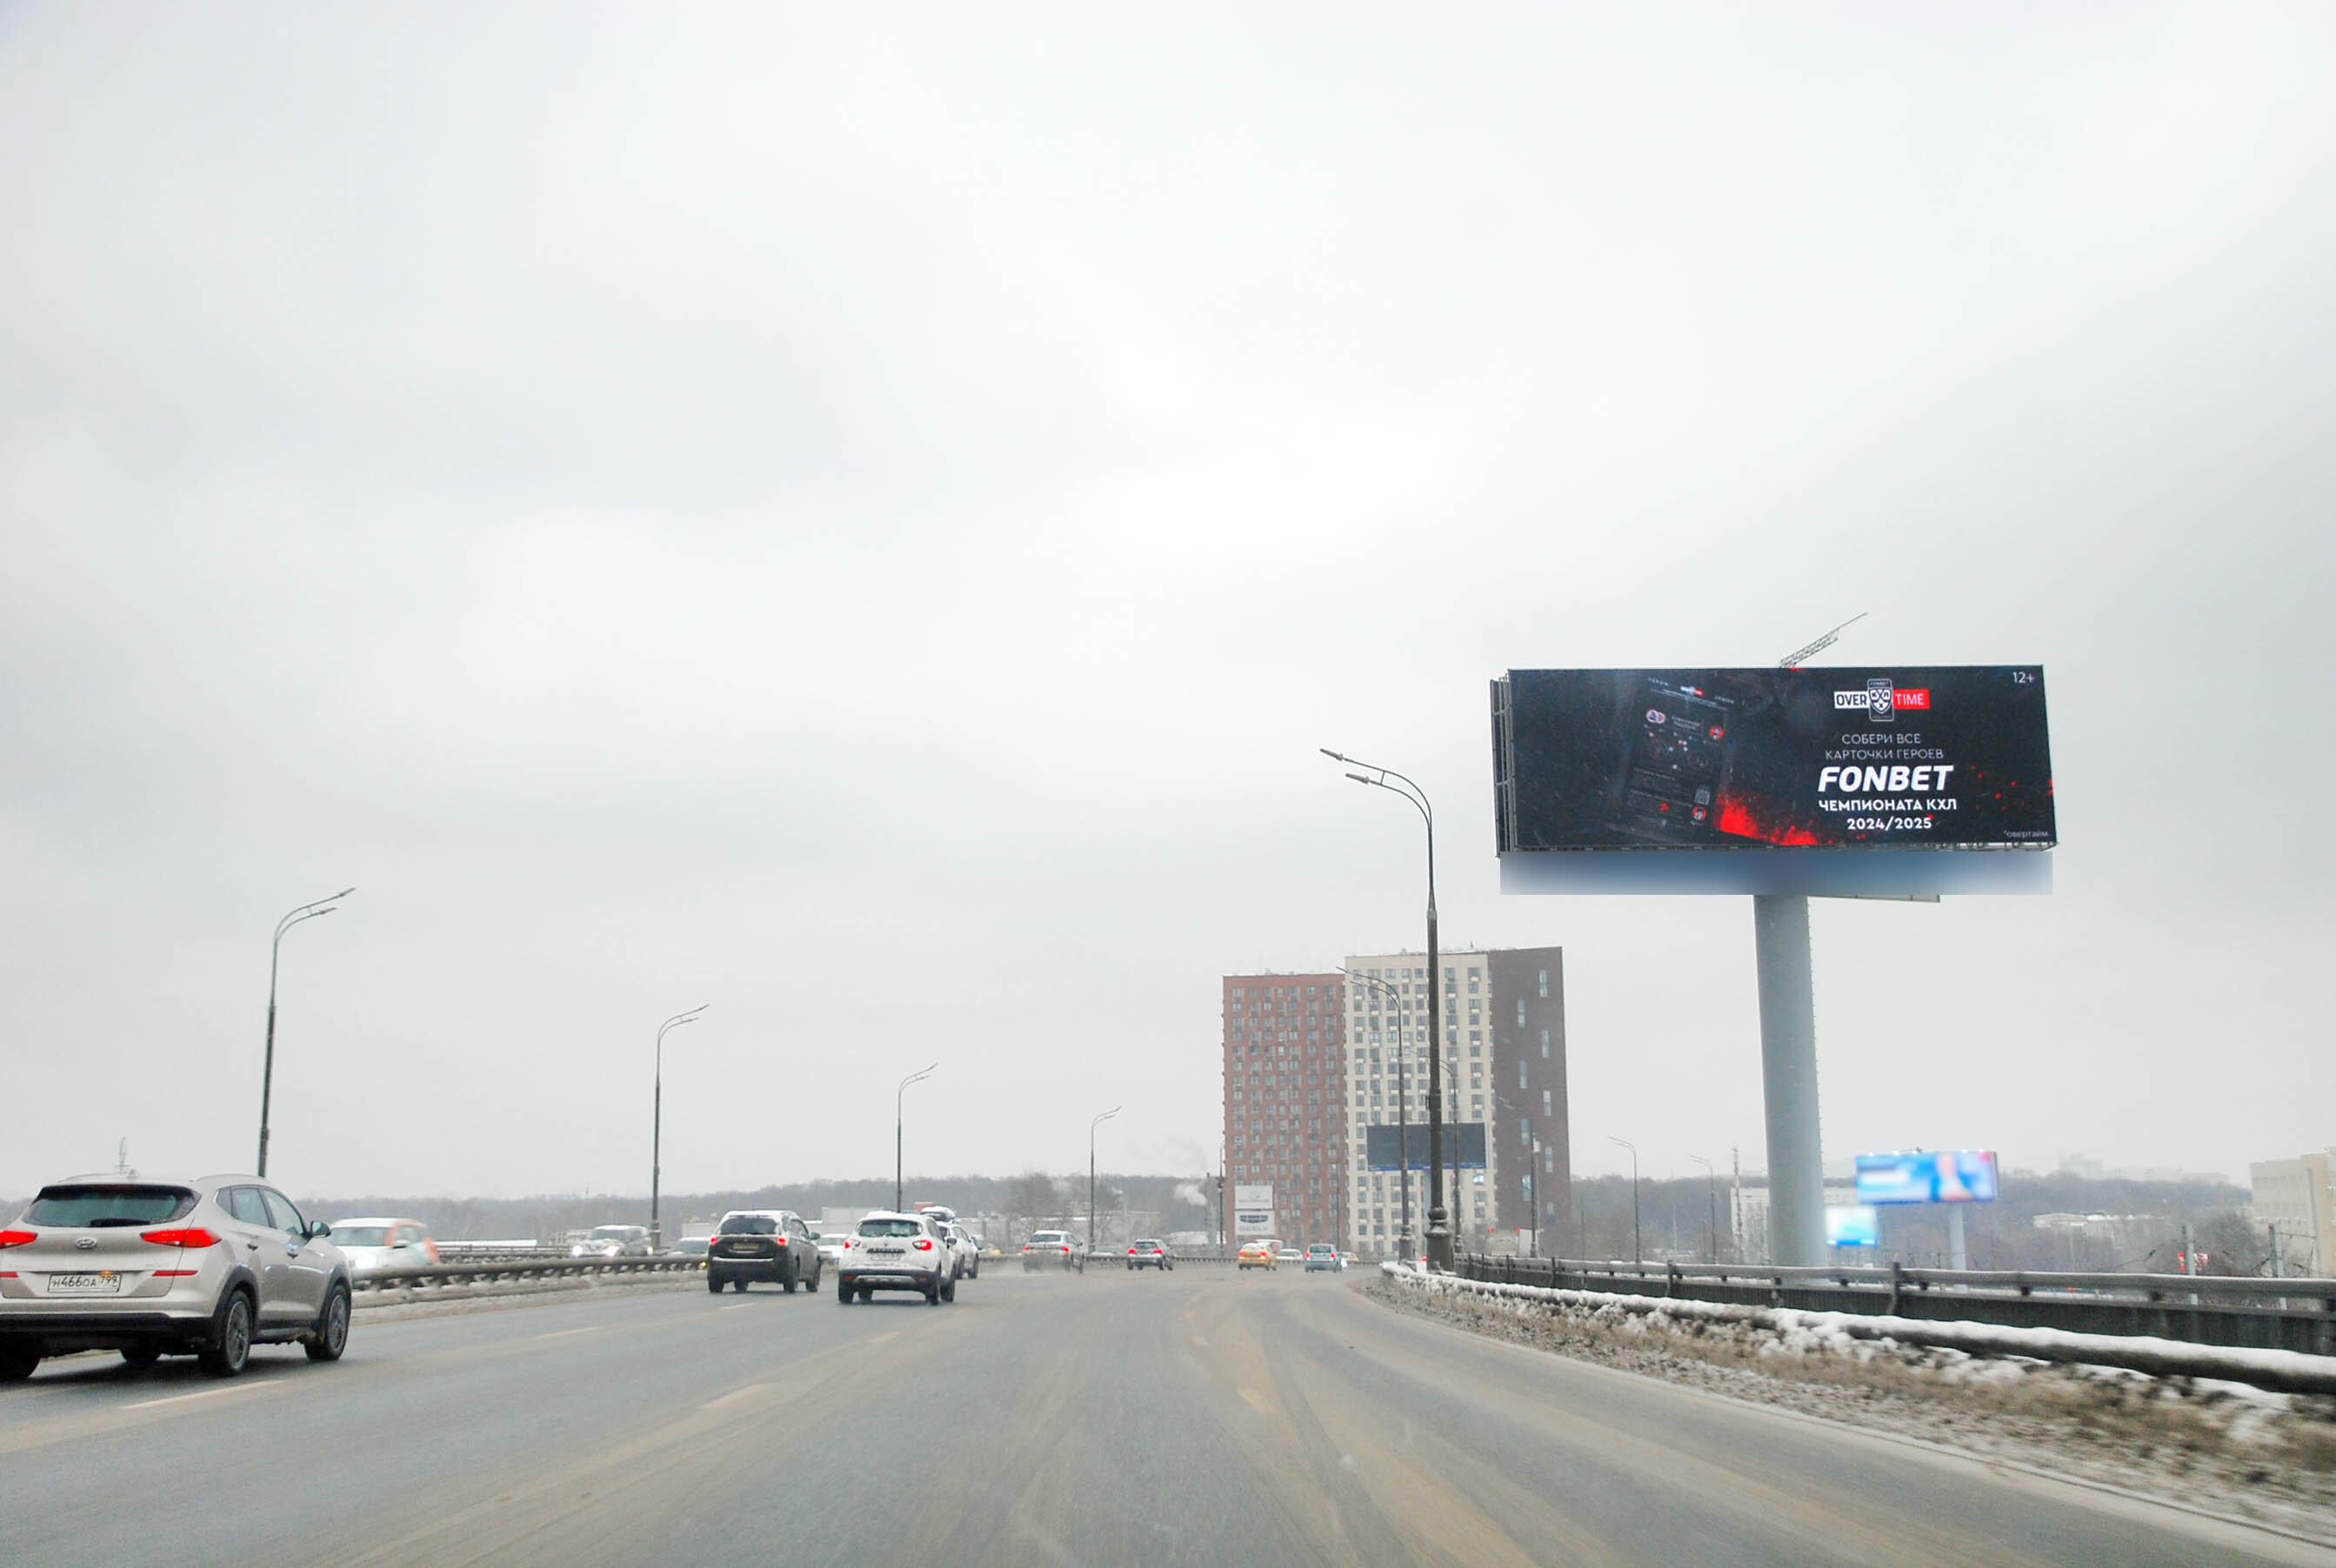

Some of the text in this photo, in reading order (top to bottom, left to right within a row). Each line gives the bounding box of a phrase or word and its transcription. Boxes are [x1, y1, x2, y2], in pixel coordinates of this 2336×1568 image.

[2012, 671, 2035, 684] 12+
[1836, 693, 1924, 705] OVER TIME
[1841, 733, 1921, 744] СОБЕРИ ВСЕ
[1825, 749, 1944, 760] КАРТОЧКИ ГЕРОЕВ
[1818, 764, 1954, 792] FONBET
[1819, 798, 1957, 811] ЧЕМПИОНАТА КХЛ
[1846, 816, 1932, 831] 2024/2025
